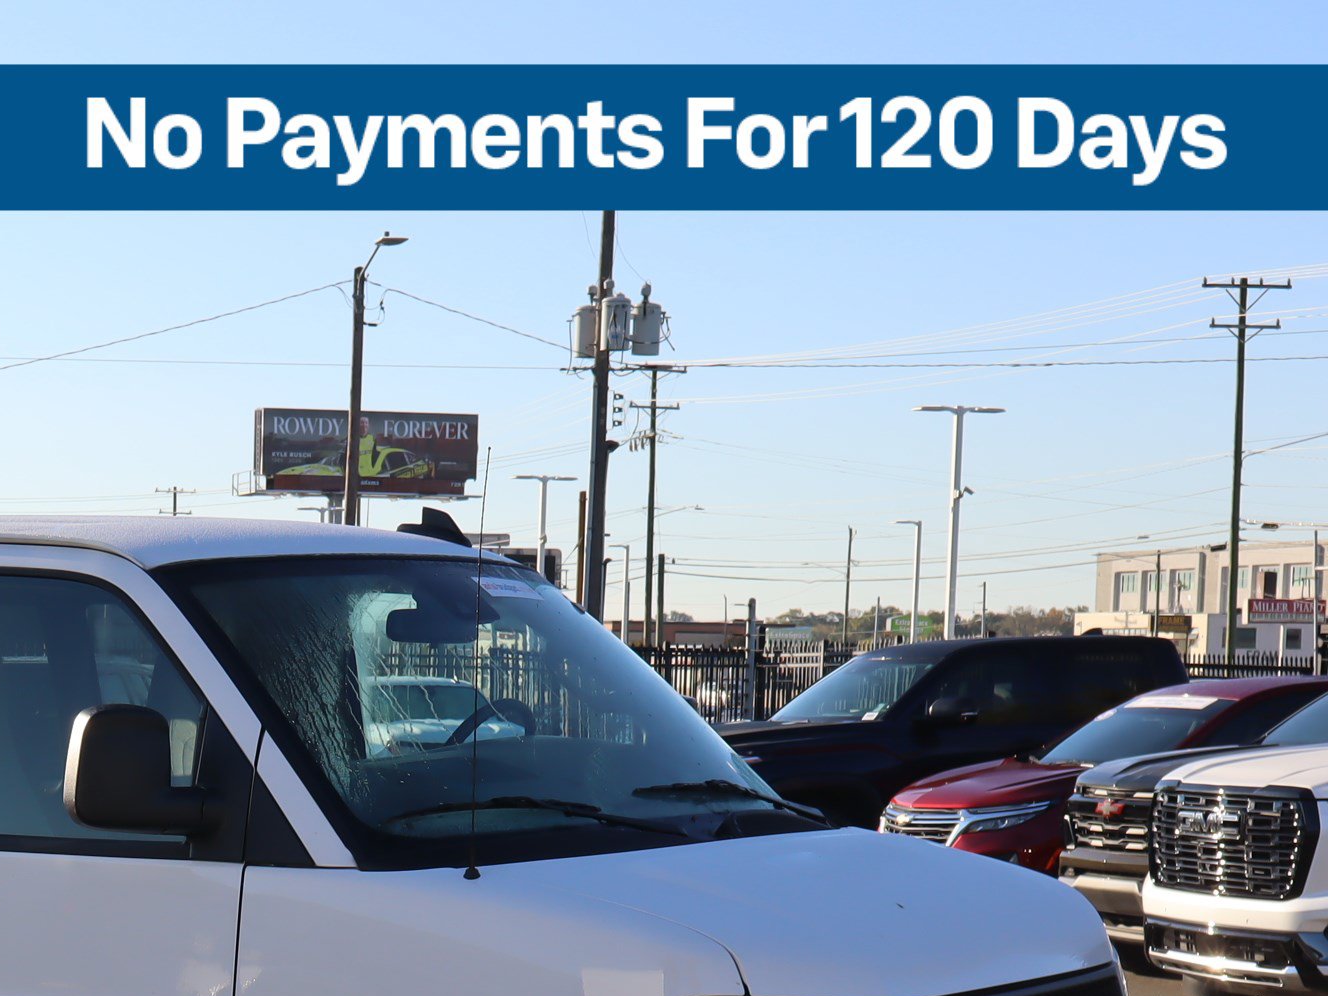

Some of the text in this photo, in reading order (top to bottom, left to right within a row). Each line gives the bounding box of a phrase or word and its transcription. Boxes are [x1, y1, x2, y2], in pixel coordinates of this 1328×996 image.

[273, 416, 469, 440] ROWDY FOREVER
[1252, 601, 1288, 613] MILLER
[1177, 810, 1239, 834] GMC
